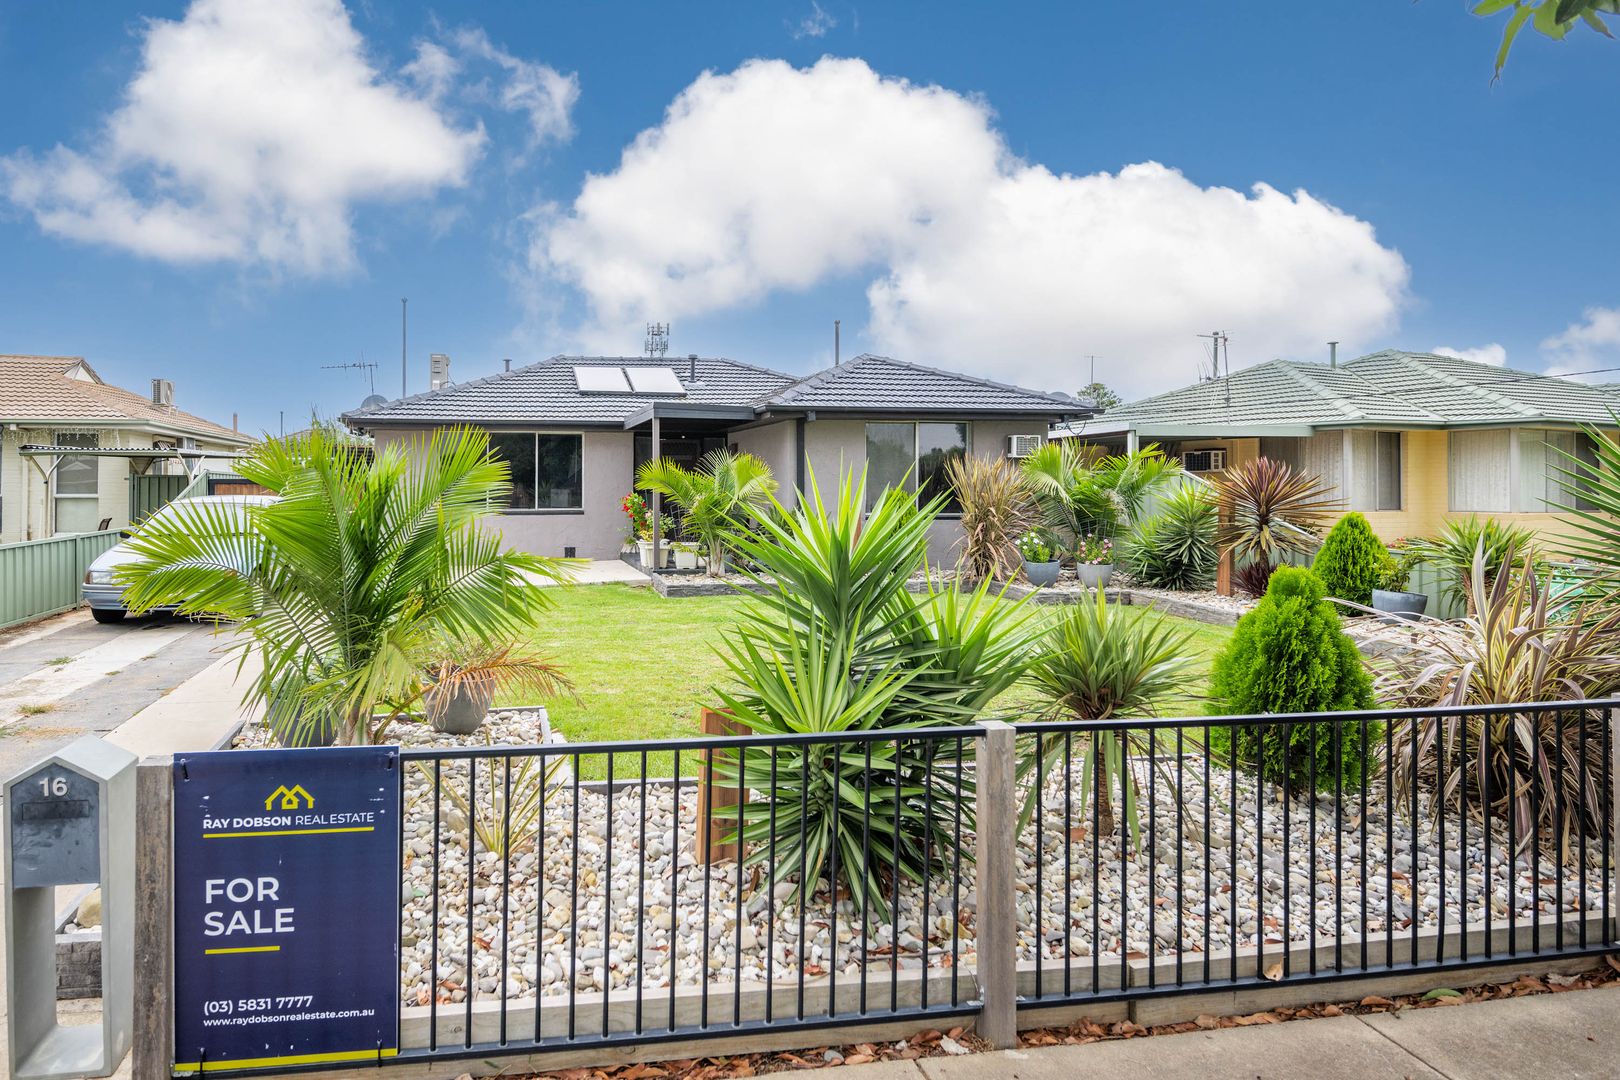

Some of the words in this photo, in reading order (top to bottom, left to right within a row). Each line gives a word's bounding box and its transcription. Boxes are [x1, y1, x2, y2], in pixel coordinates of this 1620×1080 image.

[39, 777, 68, 797] 16
[203, 818, 230, 829] RAY
[233, 816, 291, 828] DOBSON
[295, 814, 328, 825] REAL
[330, 812, 374, 823] ESTATE
[205, 877, 279, 904] FOR
[204, 908, 295, 936] SALE
[203, 1000, 233, 1015] (03)
[238, 998, 272, 1011] 5831
[275, 995, 314, 1009] 7777
[203, 1009, 375, 1026] www.raydobsonrealestate.com.au
